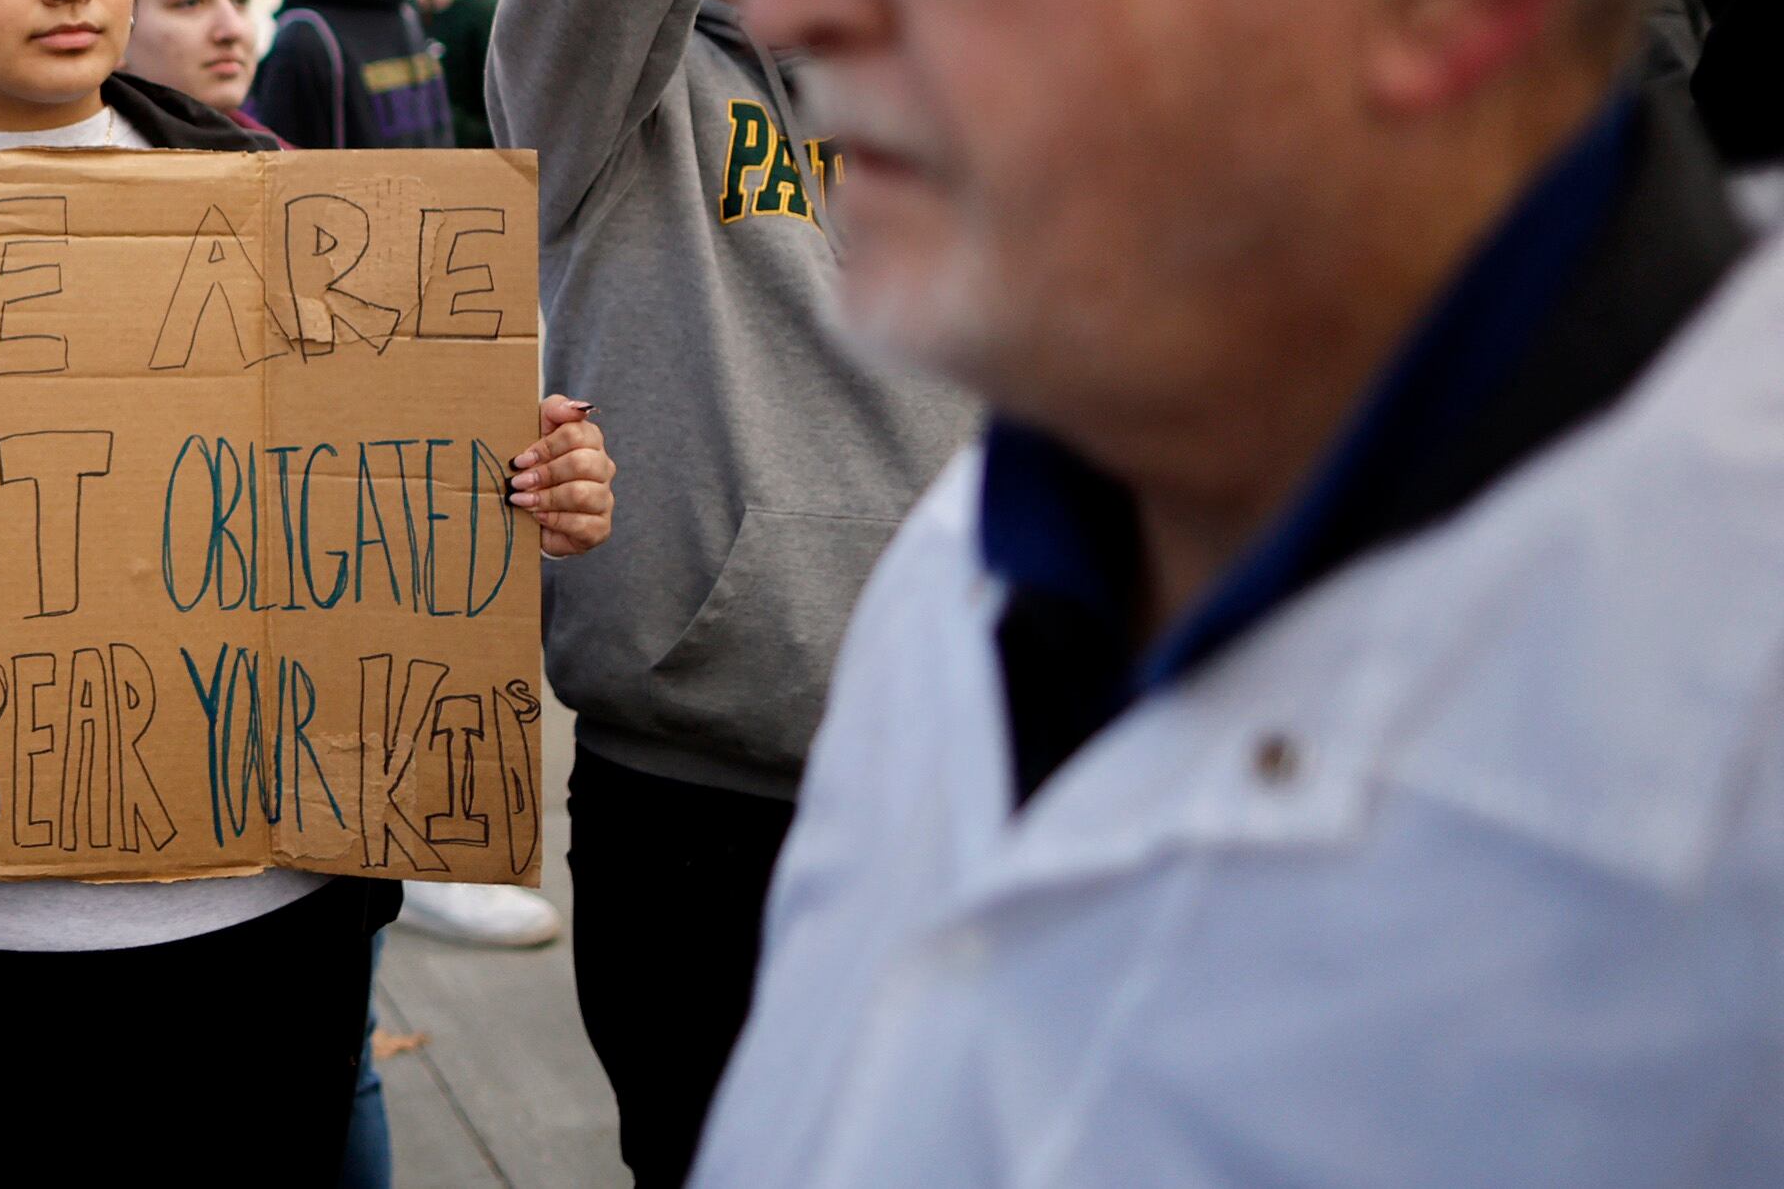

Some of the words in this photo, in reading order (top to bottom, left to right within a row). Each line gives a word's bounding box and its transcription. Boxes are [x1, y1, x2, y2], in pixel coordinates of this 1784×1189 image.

[148, 194, 507, 371] ARE
[163, 433, 516, 619] OBLIGATED
[180, 643, 347, 848] YOUR
